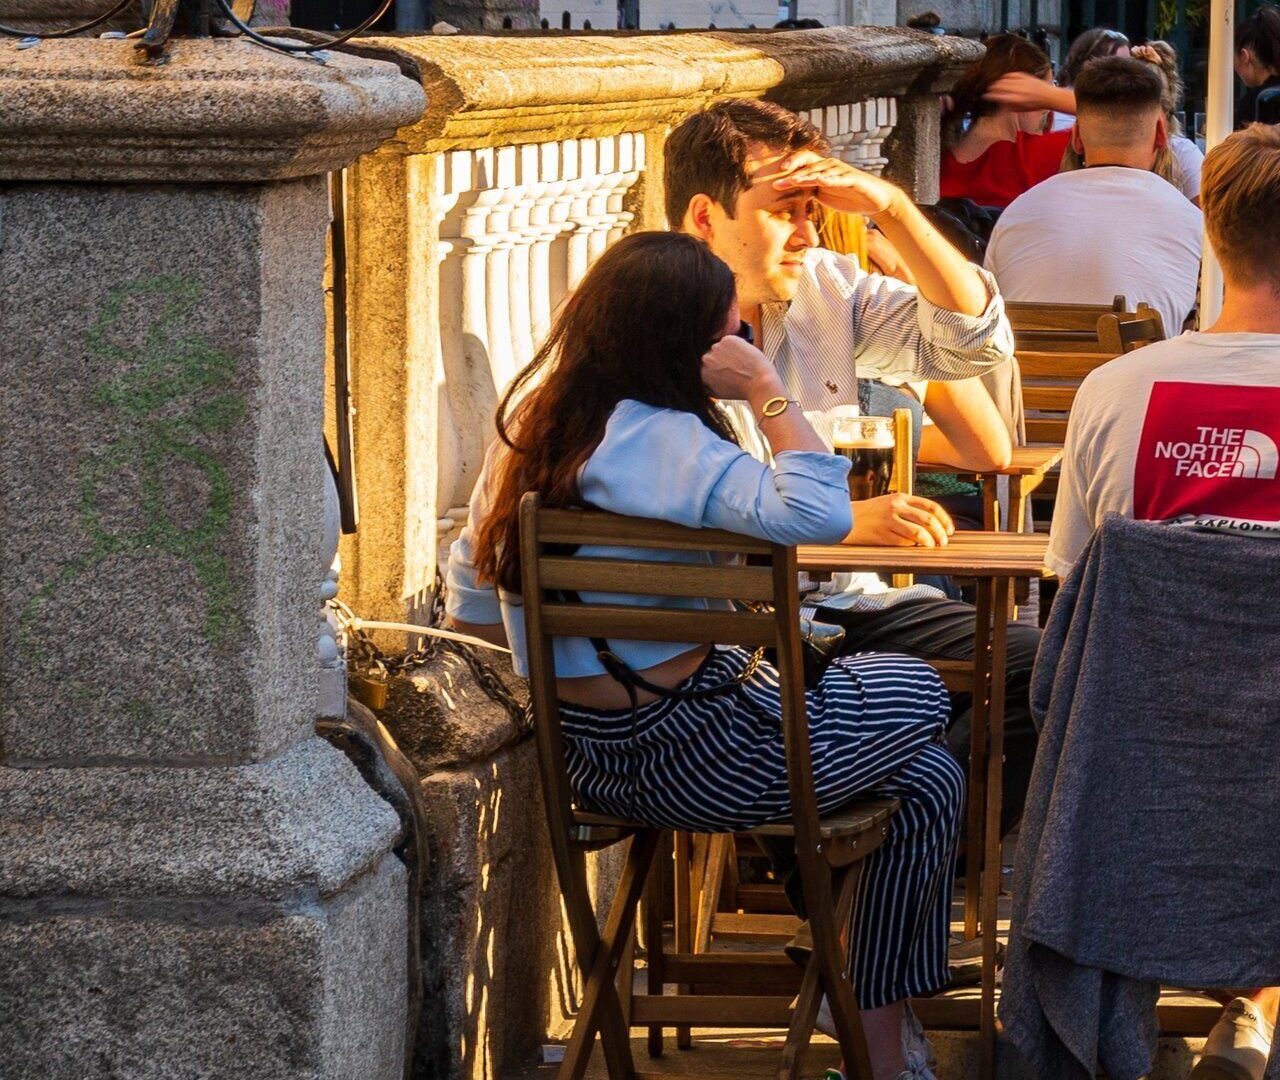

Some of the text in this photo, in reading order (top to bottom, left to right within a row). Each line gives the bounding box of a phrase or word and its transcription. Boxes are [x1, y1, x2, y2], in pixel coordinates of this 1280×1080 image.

[1197, 426, 1244, 446] THE
[1154, 441, 1241, 462] NORTH
[1175, 460, 1235, 479] FACE
